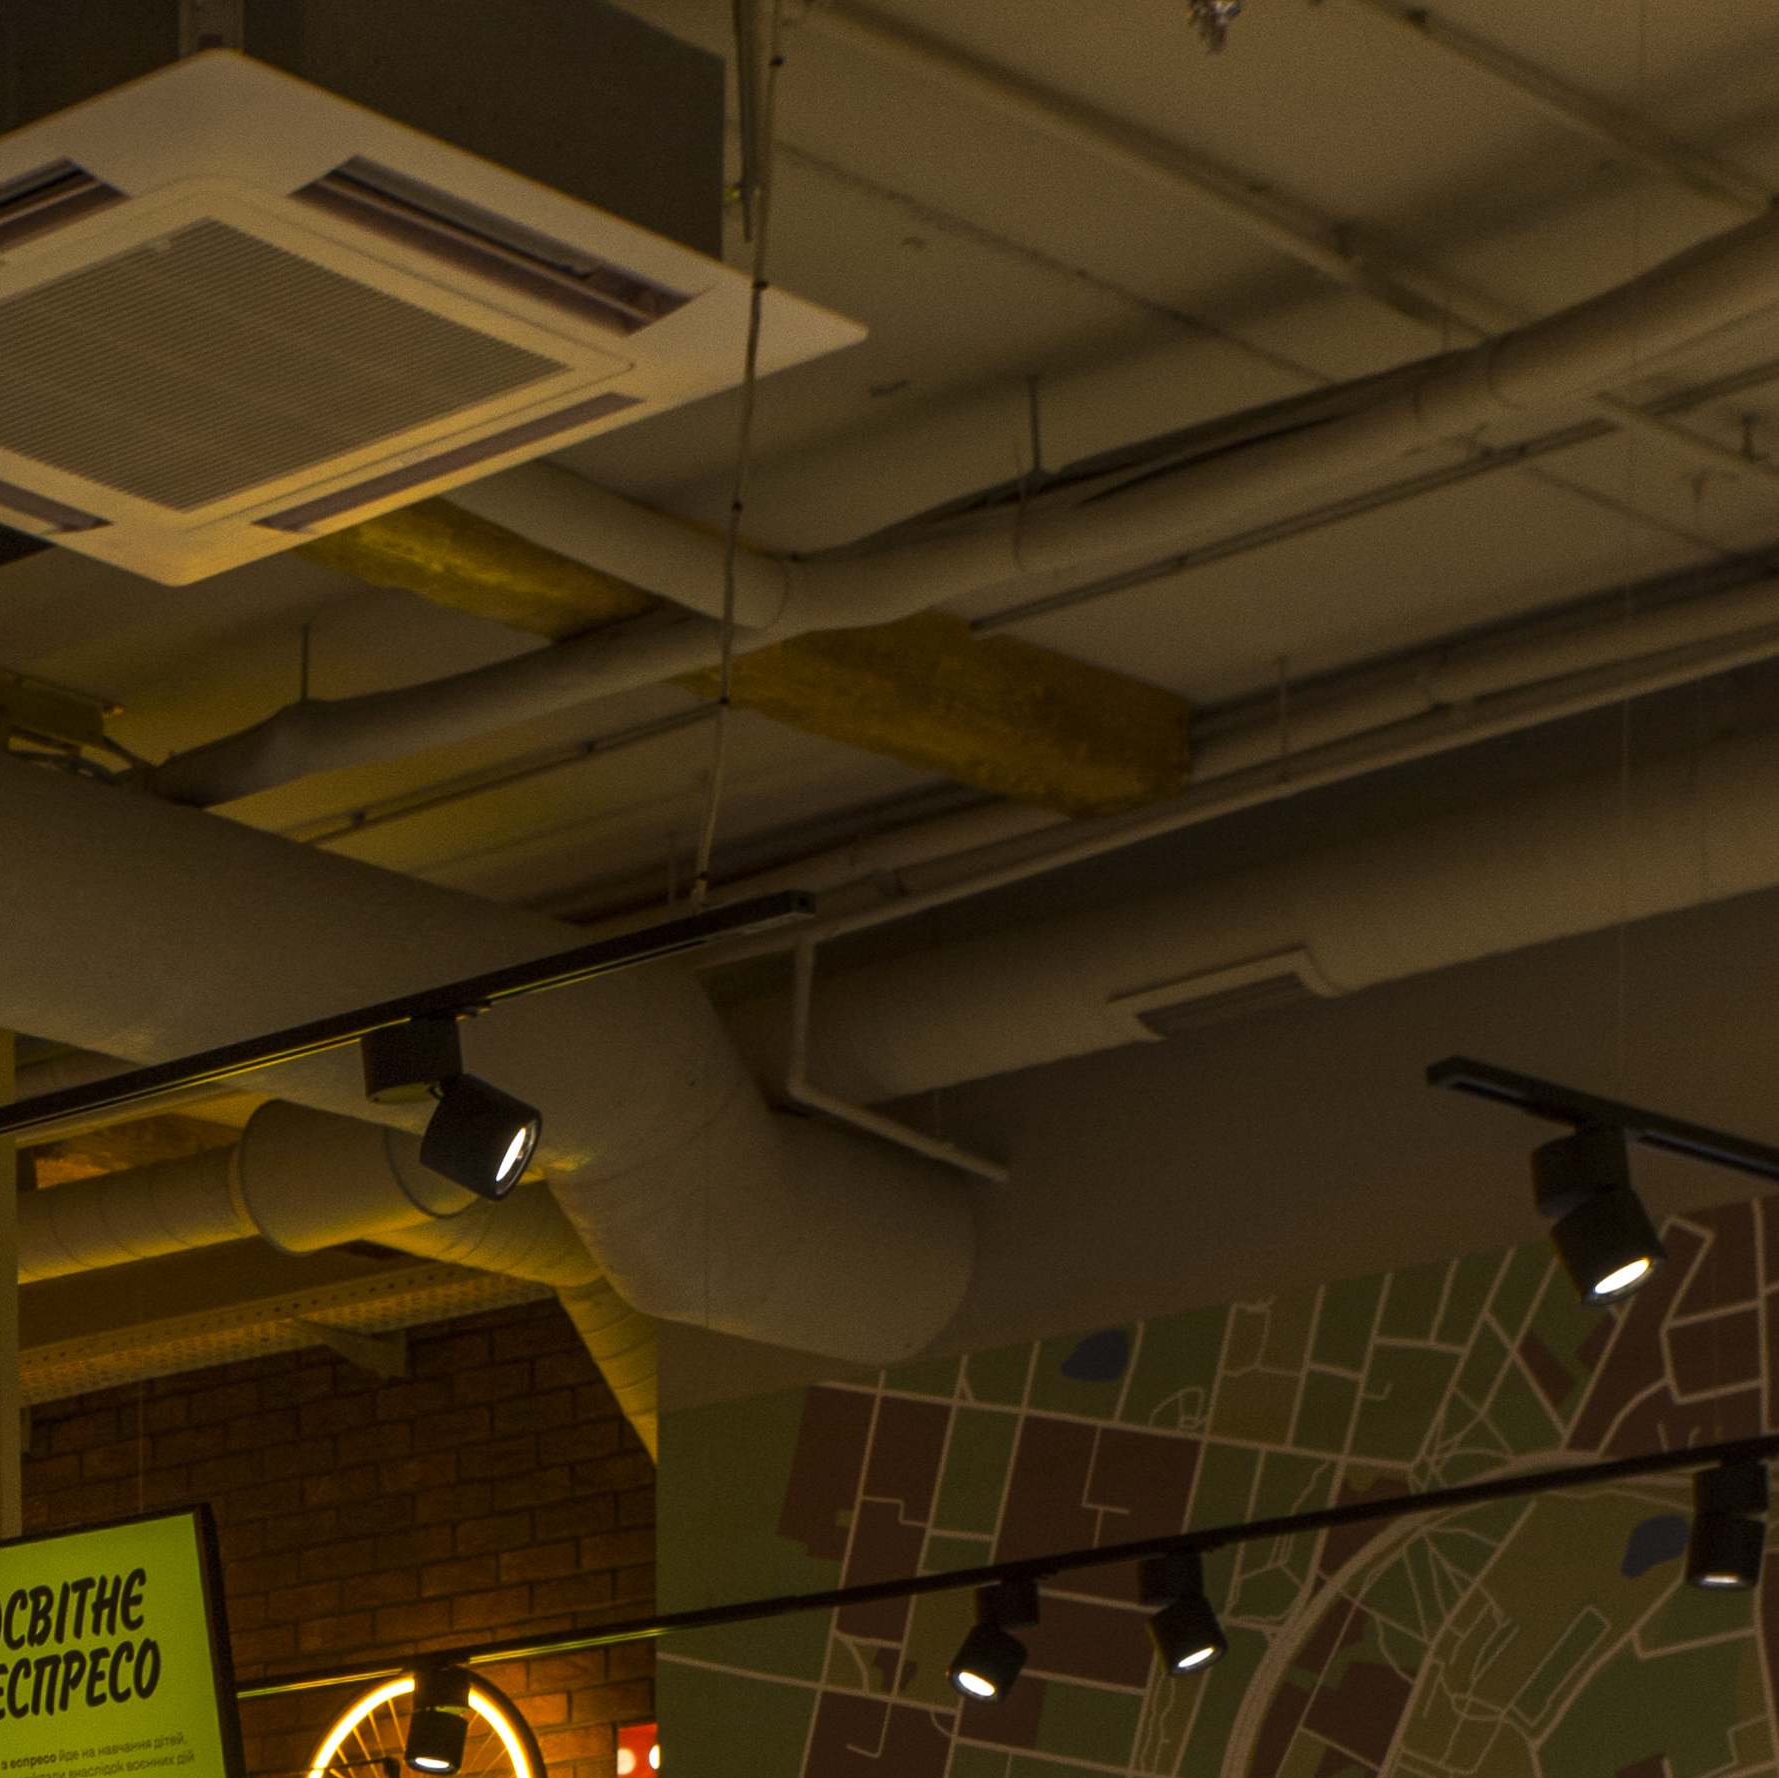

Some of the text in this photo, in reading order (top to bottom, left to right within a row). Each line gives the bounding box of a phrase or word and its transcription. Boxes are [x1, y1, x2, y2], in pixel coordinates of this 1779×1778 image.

[9, 1753, 57, 1774] еспресо
[59, 1748, 79, 1764] йде
[81, 1748, 96, 1759] на
[97, 1738, 152, 1757] навчання
[126, 1757, 175, 1774] воєнних
[177, 1752, 195, 1767] дій
